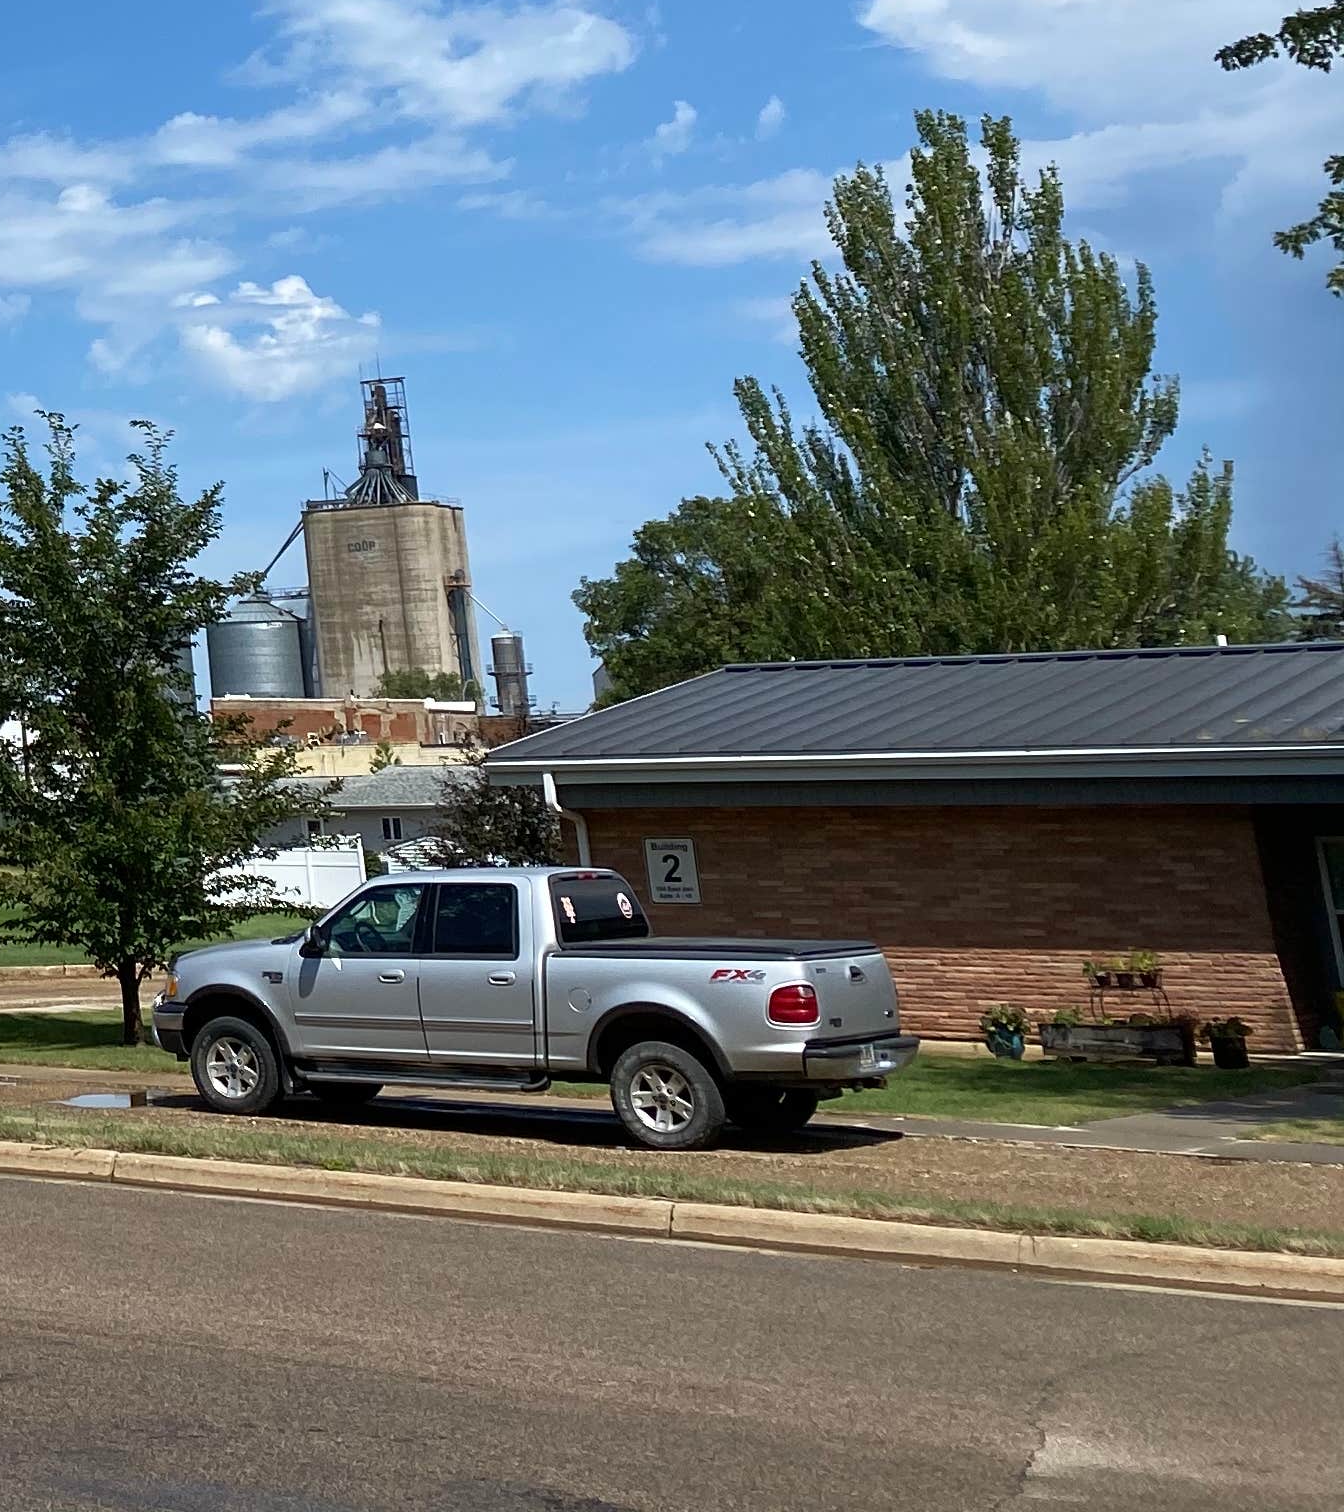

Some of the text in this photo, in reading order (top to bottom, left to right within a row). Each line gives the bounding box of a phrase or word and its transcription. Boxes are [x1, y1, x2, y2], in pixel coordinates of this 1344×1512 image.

[651, 843, 687, 852] Building
[663, 854, 682, 882] 2
[711, 969, 766, 979] FX4
